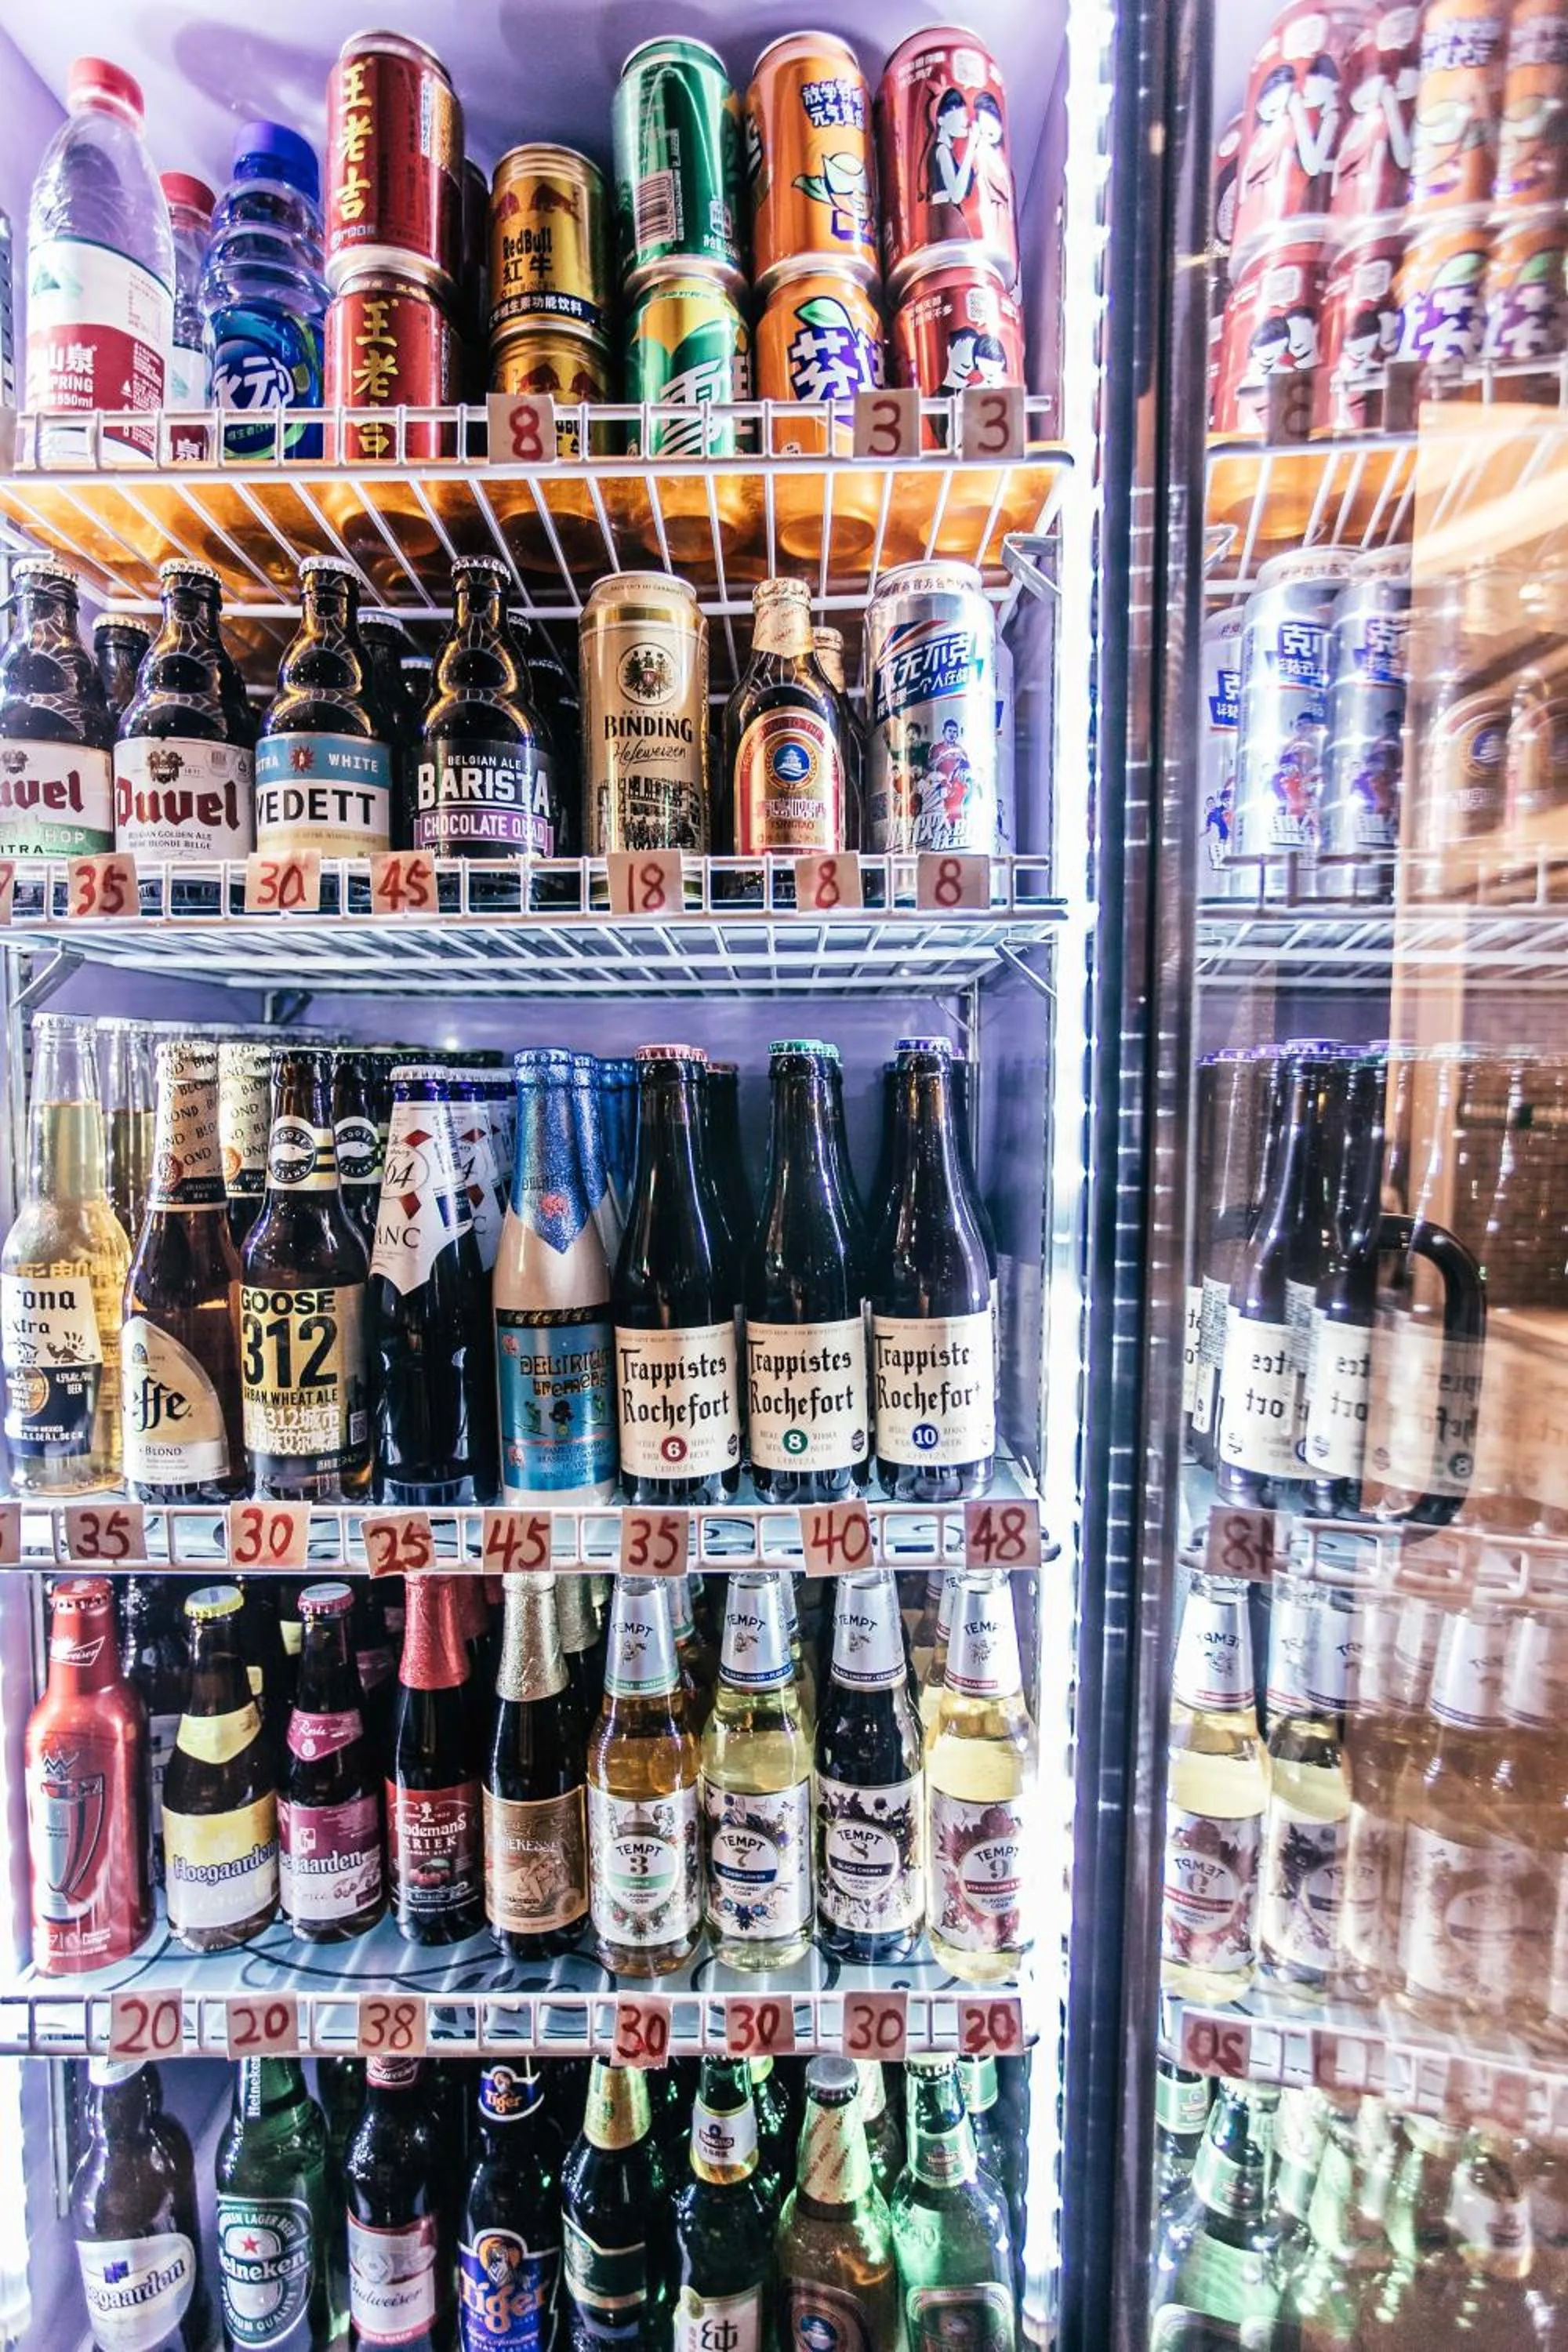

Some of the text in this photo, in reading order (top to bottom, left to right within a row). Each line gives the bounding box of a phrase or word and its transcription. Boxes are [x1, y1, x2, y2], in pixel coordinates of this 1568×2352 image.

[336, 61, 373, 222] 王老吉
[503, 226, 553, 260] RedBull
[503, 253, 553, 286] 红牛
[49, 376, 93, 393] PRING
[352, 300, 399, 453] 王老吉
[509, 405, 543, 461] 8
[867, 399, 902, 457] 3
[978, 396, 1010, 453] 3
[604, 715, 693, 744] BINDING
[328, 752, 379, 774] WHITE
[447, 755, 522, 771] BELGIAN ALE
[613, 739, 687, 766] Hefeweizen
[116, 775, 241, 831] Duvel
[257, 787, 376, 827] VEDETT
[418, 762, 550, 818] BARISTA
[44, 829, 86, 844] HOP
[158, 830, 194, 840] GOLDEN
[195, 832, 212, 842] ALE
[183, 840, 212, 851] BELGE
[424, 813, 545, 843] CHOCOLATE QUAD
[74, 863, 129, 916] 35
[256, 860, 307, 910] 30
[377, 858, 431, 911] 45
[628, 863, 666, 913] 18
[815, 859, 840, 909] 8
[935, 858, 962, 907] 8
[16, 1288, 78, 1311] ona
[241, 1287, 337, 1316] GOOSE
[242, 1313, 338, 1388] 312
[619, 1347, 728, 1389] Trappistes
[748, 1339, 852, 1381] Trappistes
[874, 1334, 971, 1377] Trappiste
[270, 1391, 314, 1406] WHEAT
[316, 1388, 338, 1403] ALE
[621, 1387, 730, 1431] Rochefort
[749, 1377, 854, 1422] Rochefort
[144, 1445, 183, 1456] BLOND
[914, 1428, 937, 1445] 10
[77, 1510, 132, 1559] 35
[235, 1507, 295, 1563] 30
[369, 1521, 432, 1576] 25
[486, 1516, 550, 1573] 45
[628, 1519, 680, 1569] 35
[811, 1510, 870, 1564] 40
[971, 1506, 1028, 1563] 48
[612, 1621, 654, 1638] TEMPT
[727, 1614, 767, 1632] TEMPT
[837, 1614, 878, 1632] TEMPT
[963, 1621, 1000, 1637] TEMP
[615, 1842, 664, 1858] TEMPT
[720, 1834, 766, 1852] TEMPT
[836, 1828, 884, 1846] TEMPT
[629, 1857, 649, 1875] 3
[989, 1859, 1010, 1880] 9
[114, 1998, 180, 2053] 20
[233, 2002, 289, 2045] 20
[361, 2002, 417, 2049] 38
[615, 2003, 666, 2058] 30
[730, 2003, 780, 2052] 30
[848, 2005, 905, 2050] 30
[962, 2002, 1018, 2054] 20
[485, 2090, 521, 2114] Tiger
[244, 2212, 278, 2227] LAGER
[220, 2249, 306, 2282] eineken
[461, 2268, 546, 2335] Tiger
